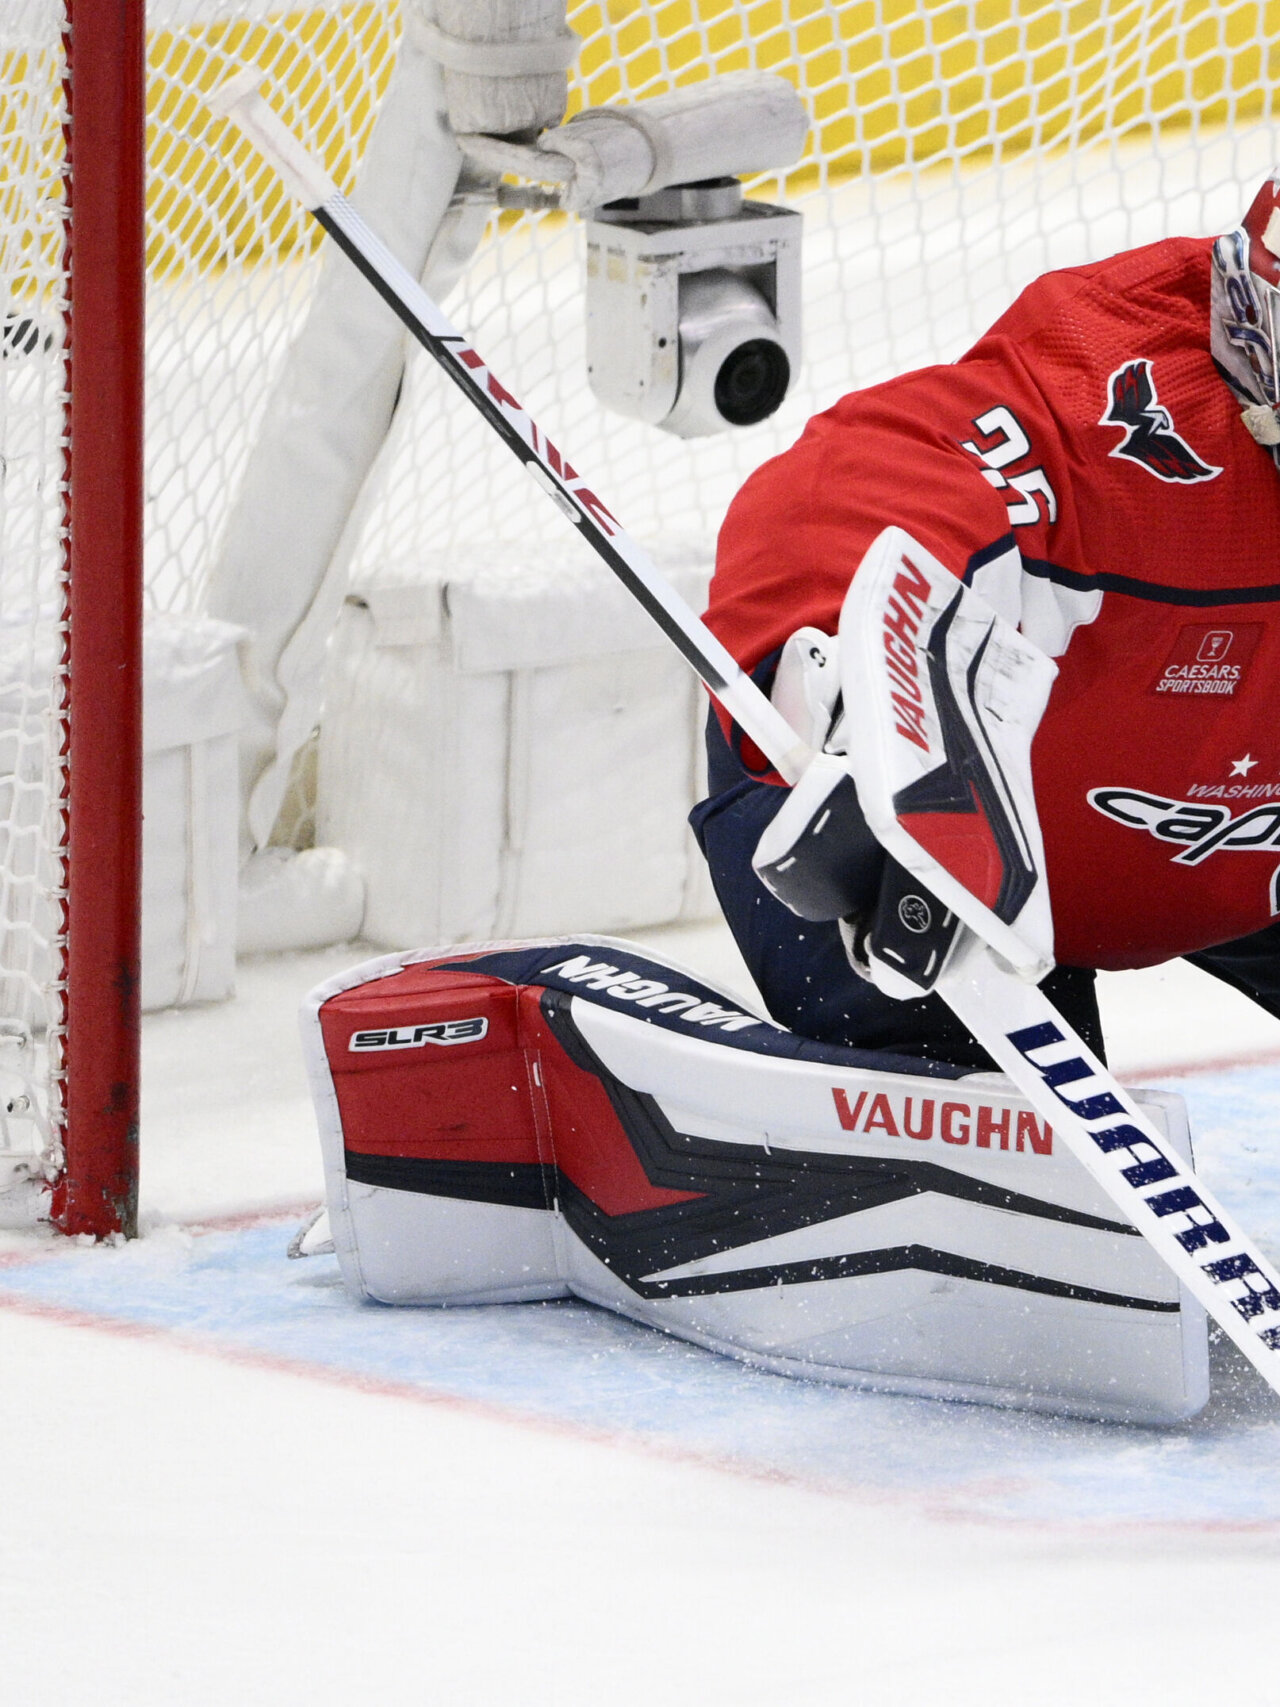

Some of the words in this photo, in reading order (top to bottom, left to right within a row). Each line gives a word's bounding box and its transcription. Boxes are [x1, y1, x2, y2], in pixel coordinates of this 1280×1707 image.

[883, 553, 932, 754] VAUGHN
[1164, 664, 1241, 679] CAESARS
[1156, 679, 1237, 695] SPORTSBOOK
[540, 954, 763, 1033] VAUGHN
[354, 1018, 484, 1048] SLR3
[831, 1086, 1053, 1156] VAUGHN
